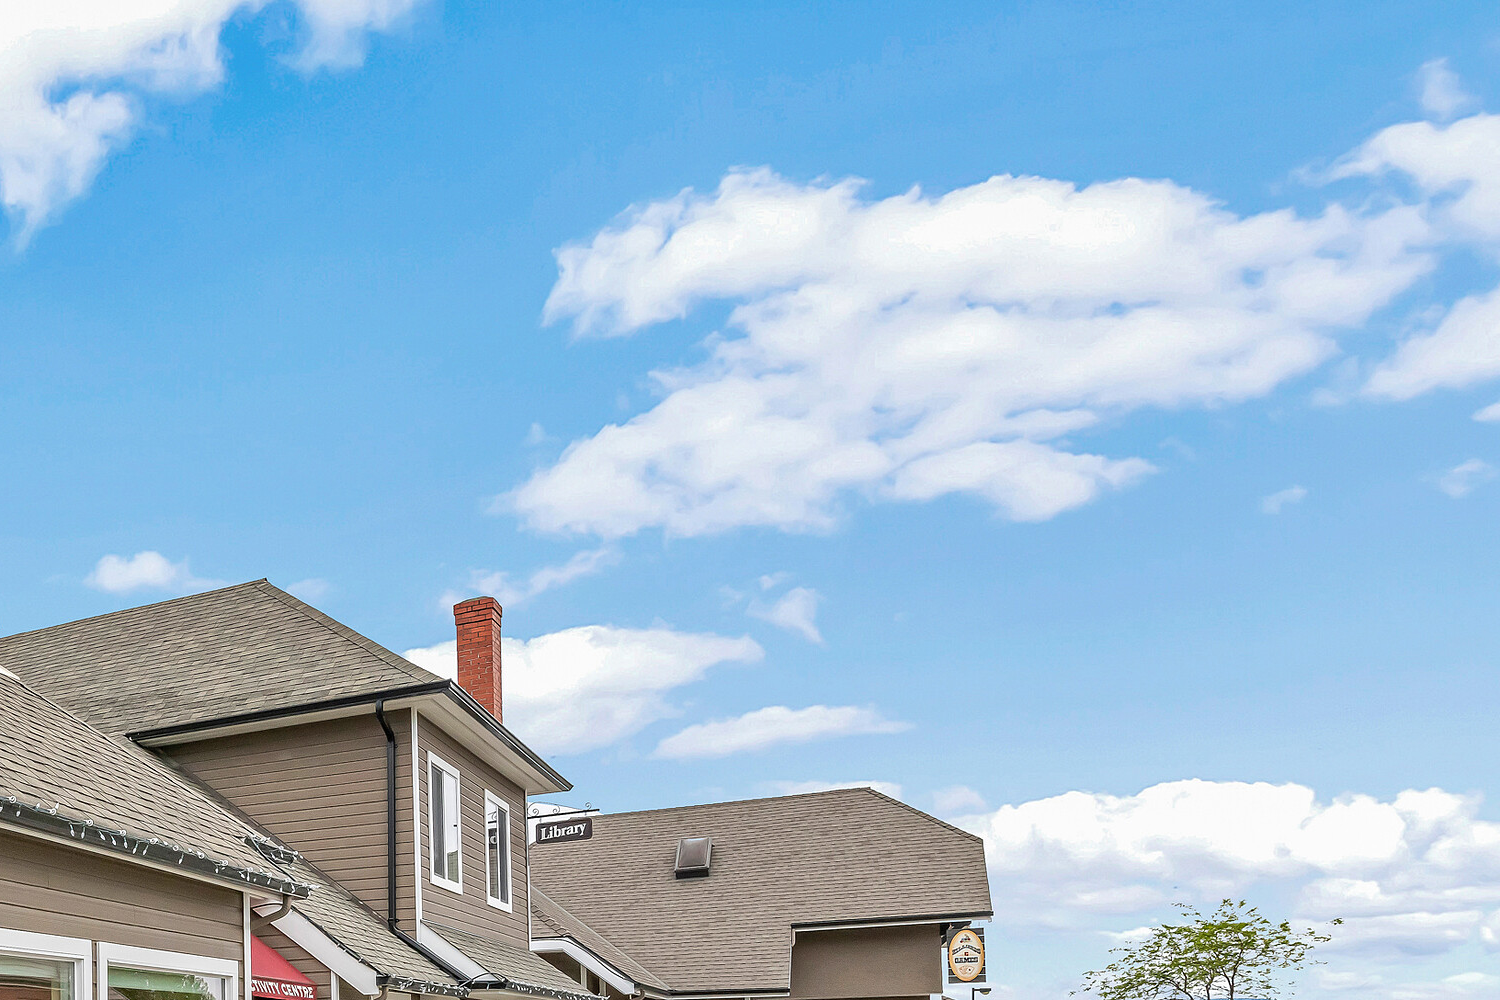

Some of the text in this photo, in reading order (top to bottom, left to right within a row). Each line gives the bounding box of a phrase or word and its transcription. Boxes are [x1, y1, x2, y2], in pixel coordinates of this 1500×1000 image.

[540, 823, 587, 841] Library
[251, 979, 314, 999] CTIVITY CENTRE
